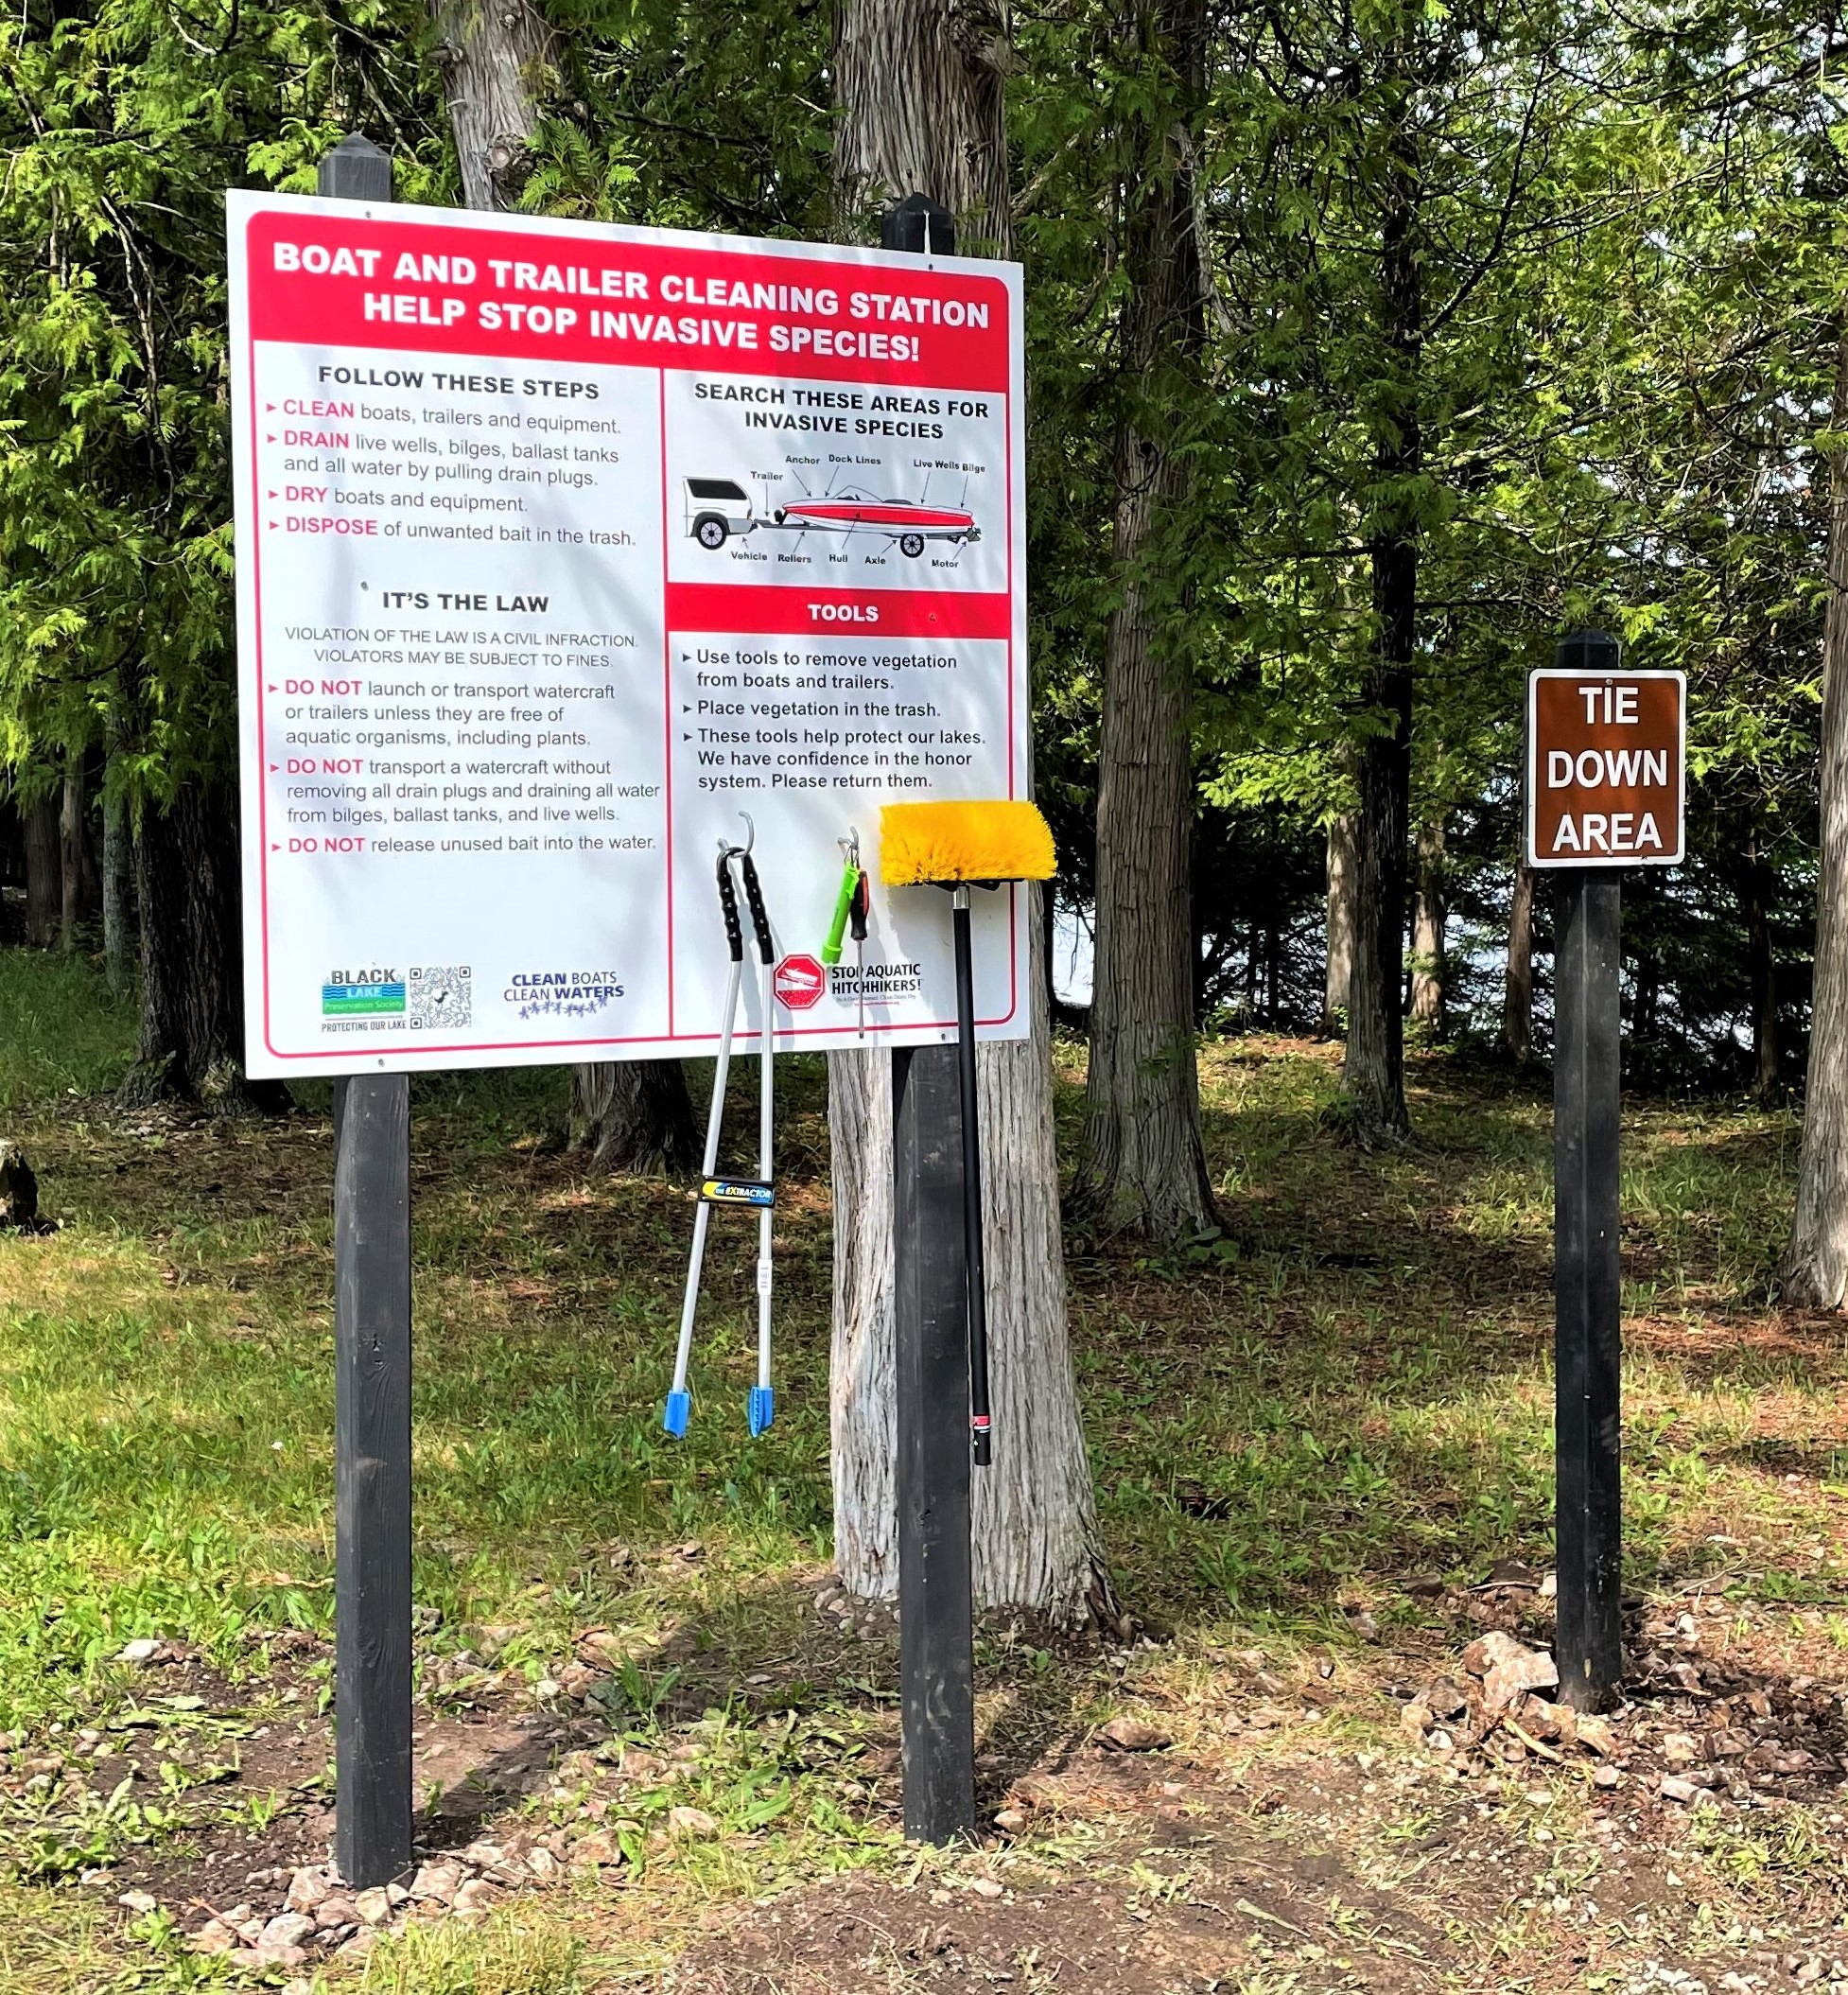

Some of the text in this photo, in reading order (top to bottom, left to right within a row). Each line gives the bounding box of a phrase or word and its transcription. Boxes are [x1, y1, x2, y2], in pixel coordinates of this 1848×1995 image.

[273, 242, 987, 328] BOAT AND TRAILER CLEANING STATION
[364, 293, 918, 361] HELP STOP INVASIVE SPECIES!
[319, 366, 599, 399] FOLLOW THESE STEPS
[695, 383, 988, 418] SEARCH THESE AREAS FOR
[284, 399, 620, 434] CLEAN boats, trailers and equipment.
[746, 412, 943, 439] INVASIVE SPECIES
[285, 430, 619, 463] DRAIN live wells, bilges, ballast tanks
[786, 456, 820, 464] Anchor
[829, 454, 880, 464] Dock Lines
[934, 461, 959, 470] Wells
[285, 456, 597, 488] and all water by pulling drain plugs.
[751, 471, 783, 481] Trailer
[962, 464, 985, 473] Bilge
[286, 486, 528, 513] DRY boats and equipment.
[288, 516, 636, 545] DISPOSE of unwanted bait in the trash.
[731, 551, 767, 560] Vehicle
[778, 554, 811, 563] Rollers
[932, 559, 958, 568] Motor
[383, 592, 549, 612] IT'S THE LAW
[808, 604, 879, 621] TOOLS
[286, 627, 639, 647] VIOLATION OF THE LAW IS A CIVIL INFRACTION.
[314, 649, 613, 667] VIOLATORS MAY BE SUBJECT TO FINES.
[698, 649, 956, 671] Use tools to remove vegetation
[697, 672, 894, 689] from boats and trailers.
[286, 680, 615, 701] DO NOT launch or transport watercraft
[698, 700, 940, 719] Place vegetation in the trash.
[1578, 686, 1639, 724] TIE
[287, 729, 590, 748] aquatic organisms, including plants.
[698, 728, 985, 746] These tools help protect our lakes.
[288, 760, 611, 778] DO NOT transport a watercraft without
[1548, 749, 1667, 788] DOWN
[699, 774, 932, 792] system. Please return them.
[288, 806, 619, 825] from bilges, ballast tanks, and live wells.
[1552, 812, 1663, 851] AREA
[289, 835, 655, 852] DO NOT release unused bait into the water.
[331, 969, 396, 985] BLACK
[512, 971, 617, 987] CLEAN BOATS
[866, 964, 921, 979] AQUATIC
[346, 986, 382, 997] LAKE
[504, 986, 624, 1002] CLEAN WATERS
[832, 979, 921, 994] HITCHHIKERS!
[322, 1020, 407, 1033] PROTECTING OUR LAKE
[725, 1186, 771, 1198] EXTRACTOR
